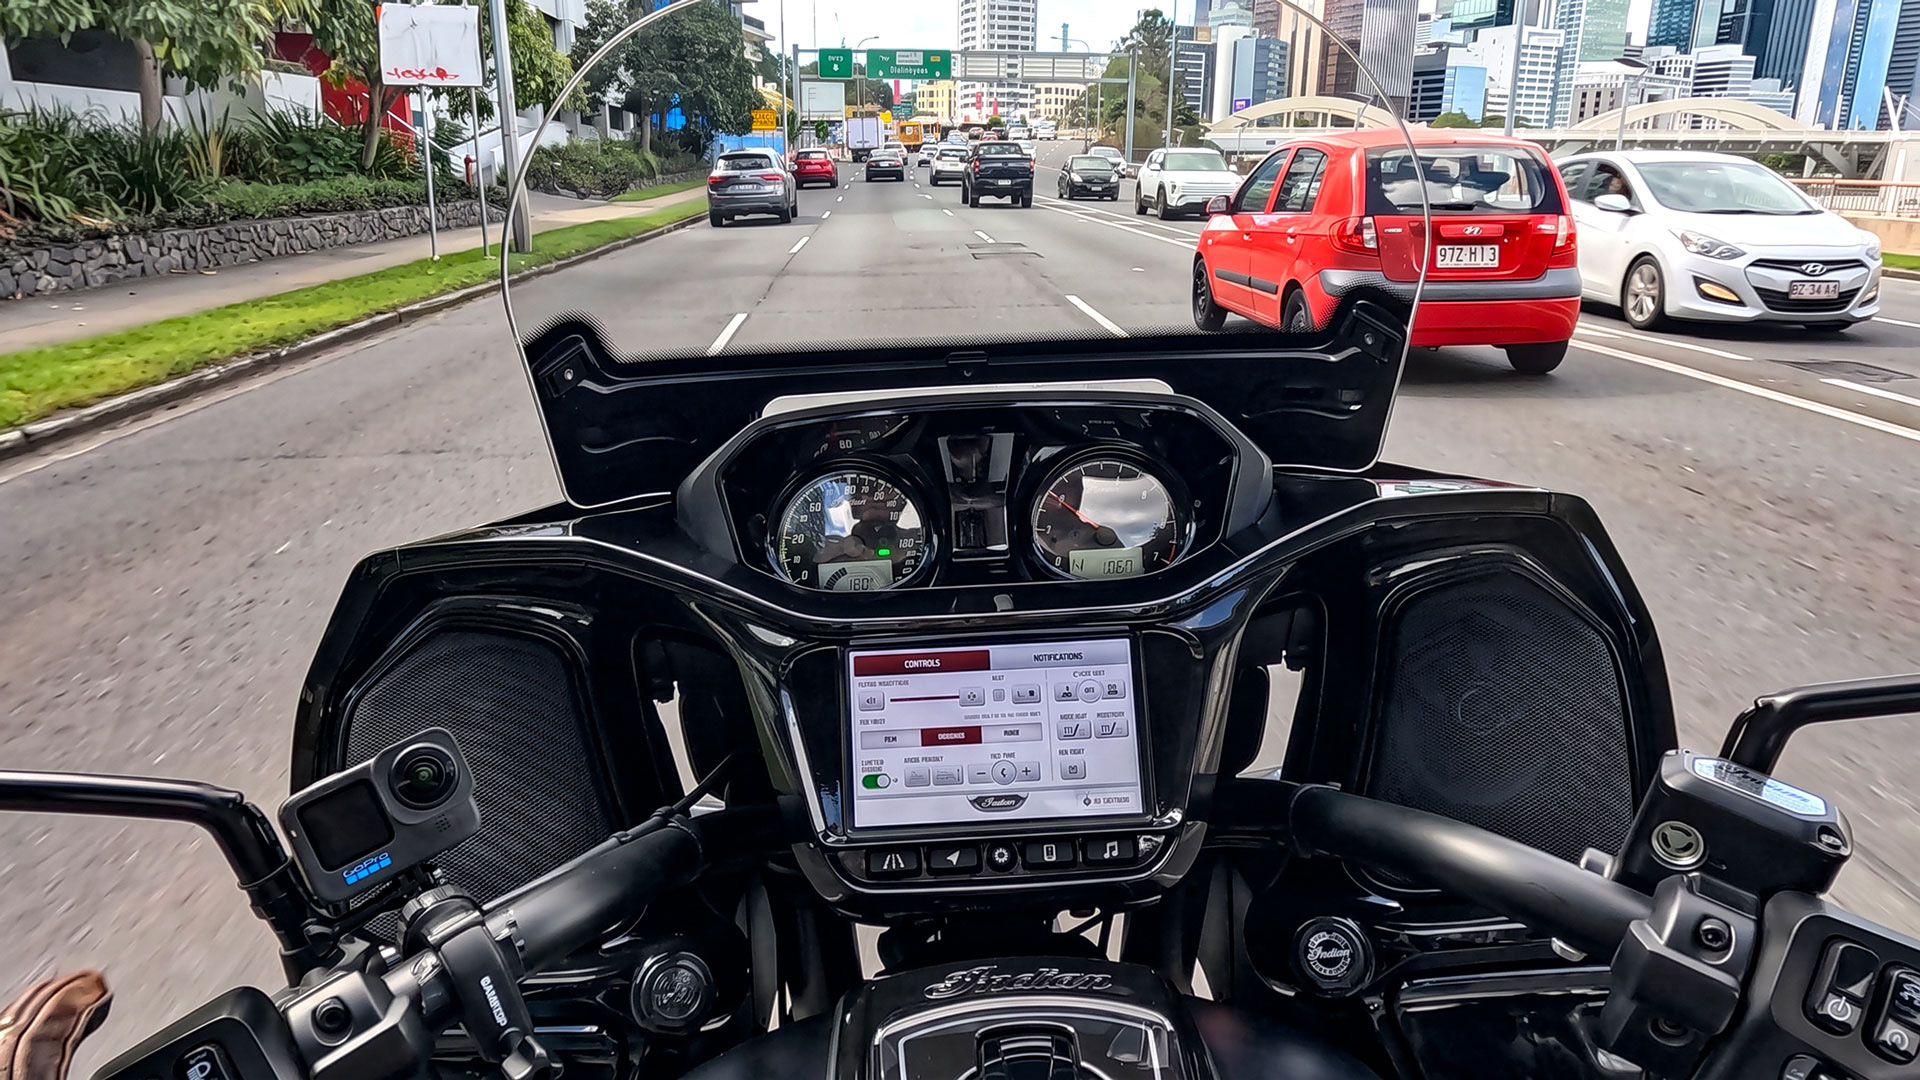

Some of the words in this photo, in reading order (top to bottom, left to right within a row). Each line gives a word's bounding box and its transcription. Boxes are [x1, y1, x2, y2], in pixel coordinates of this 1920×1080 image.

[809, 502, 822, 512] 60
[791, 533, 805, 544] 20
[1033, 652, 1083, 662] NOTIFICATIONS
[904, 658, 941, 669] CONTROLS
[342, 851, 390, 879] GoPro
[1307, 946, 1350, 961] Indian
[923, 964, 1113, 1000] Indian
